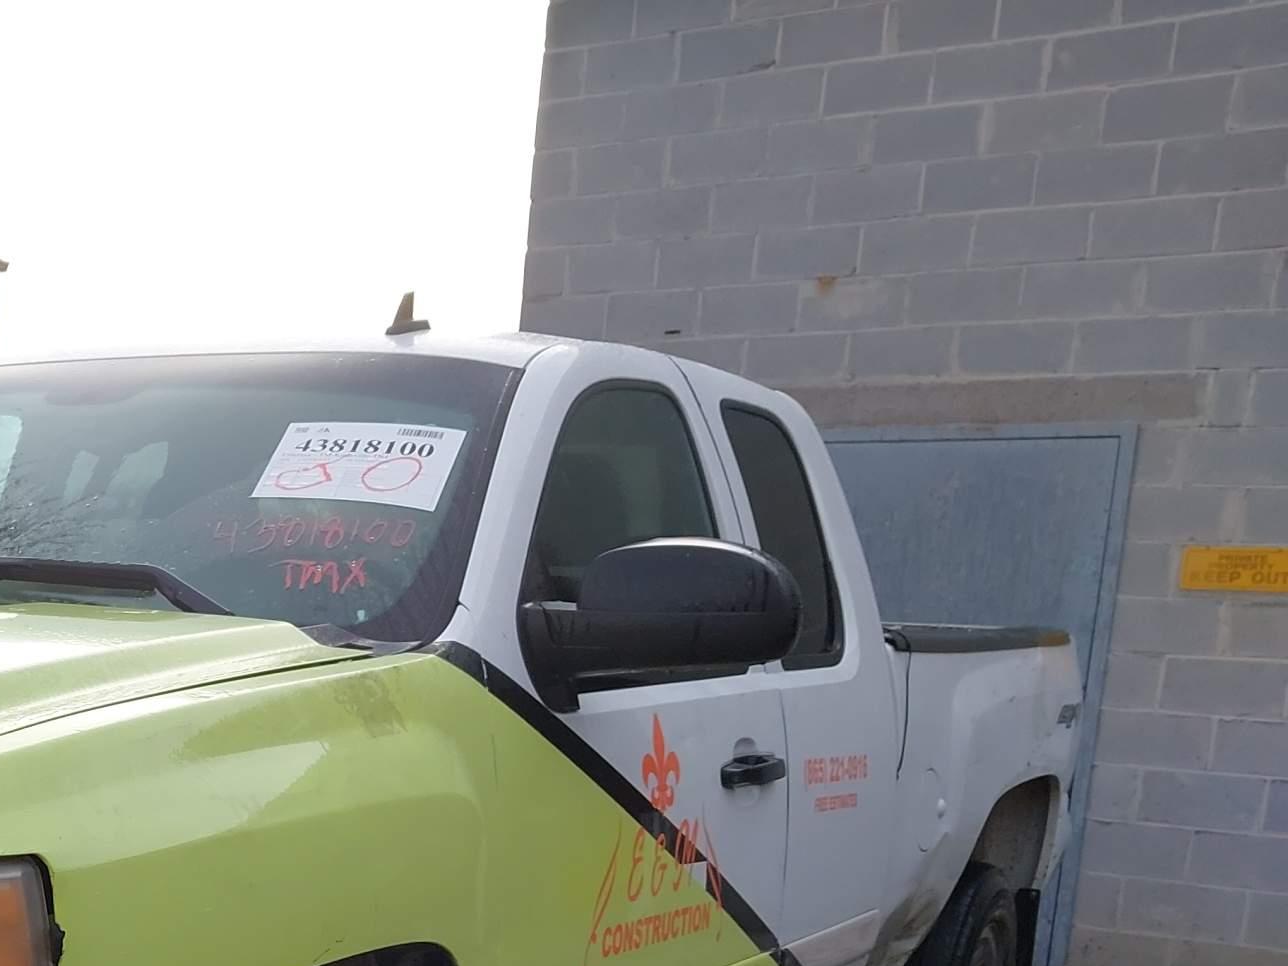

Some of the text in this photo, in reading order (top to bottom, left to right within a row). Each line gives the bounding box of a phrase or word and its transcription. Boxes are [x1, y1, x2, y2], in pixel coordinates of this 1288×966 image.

[295, 438, 435, 458] 43818100
[268, 557, 368, 595] TMX
[601, 902, 712, 958] CONSTRUCTION
